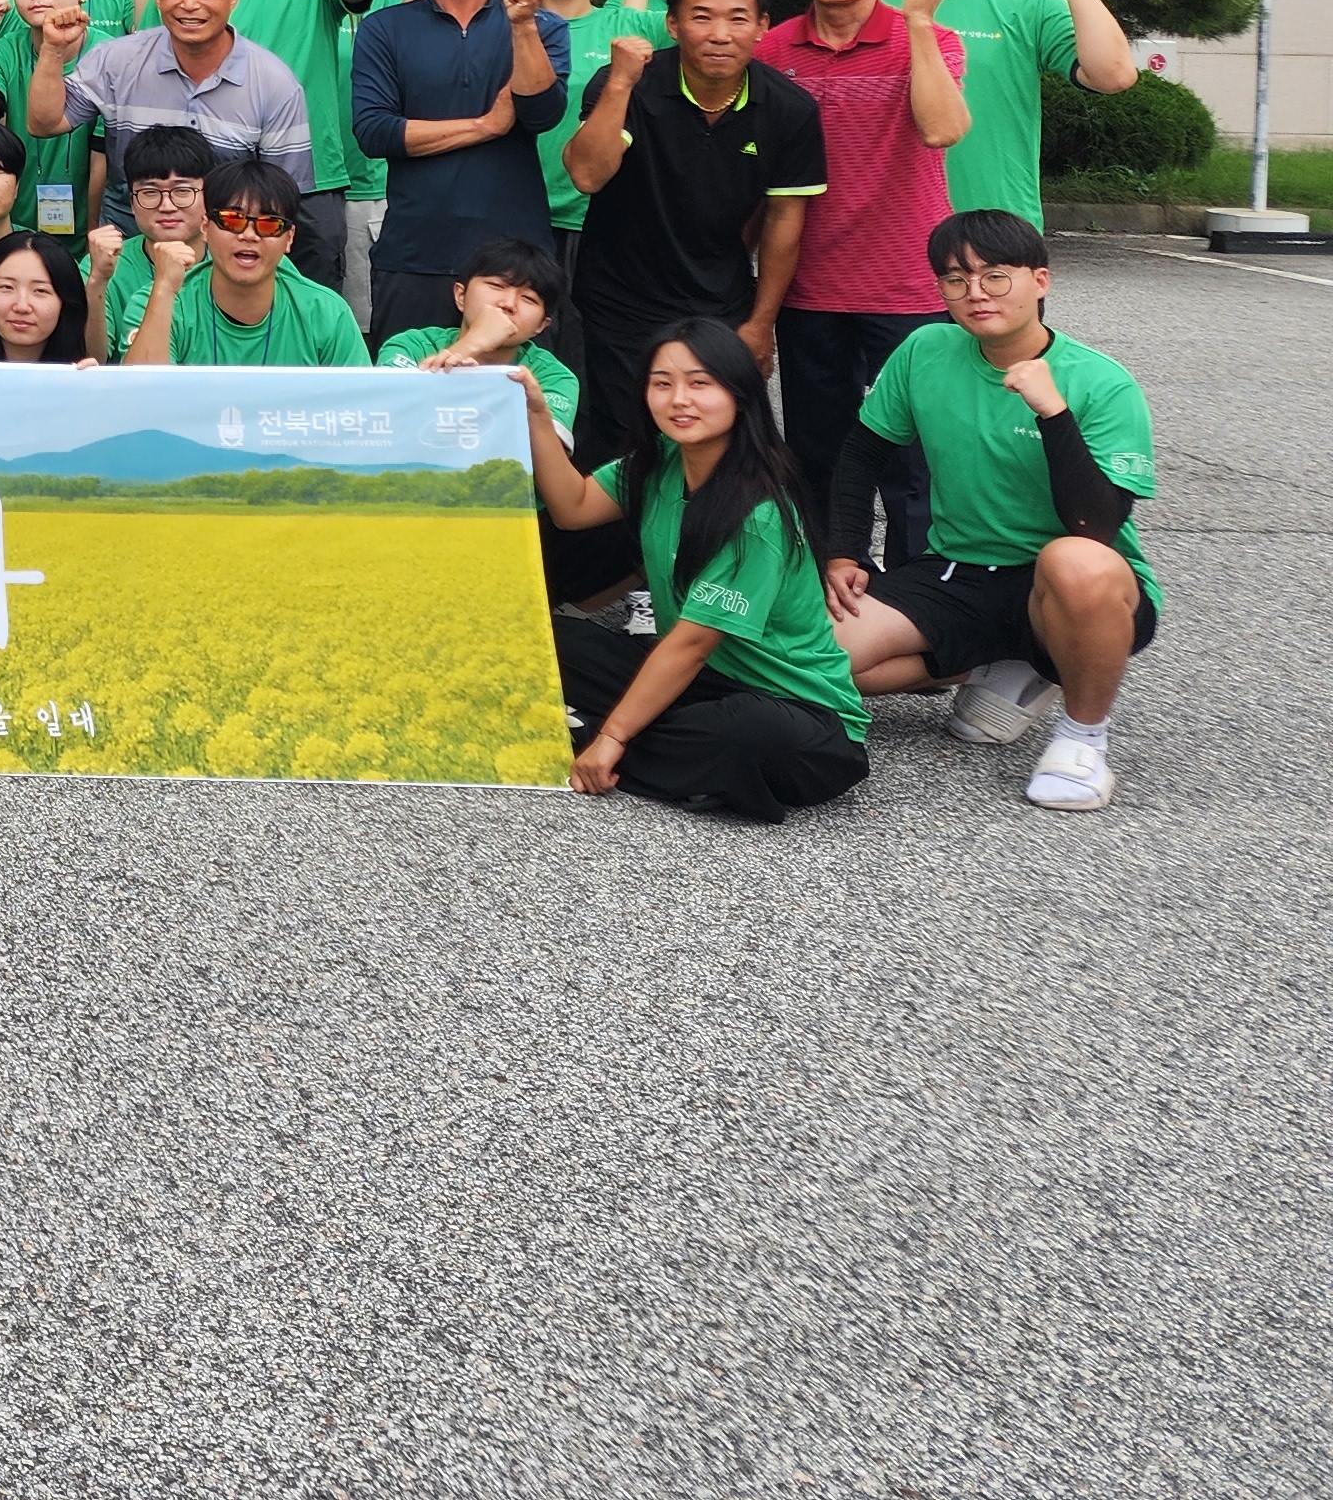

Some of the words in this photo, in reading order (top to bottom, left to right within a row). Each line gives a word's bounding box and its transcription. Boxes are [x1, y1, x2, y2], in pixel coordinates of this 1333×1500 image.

[256, 408, 394, 438] 전북대학교
[691, 580, 750, 617] 57th
[36, 699, 96, 739] 일대
